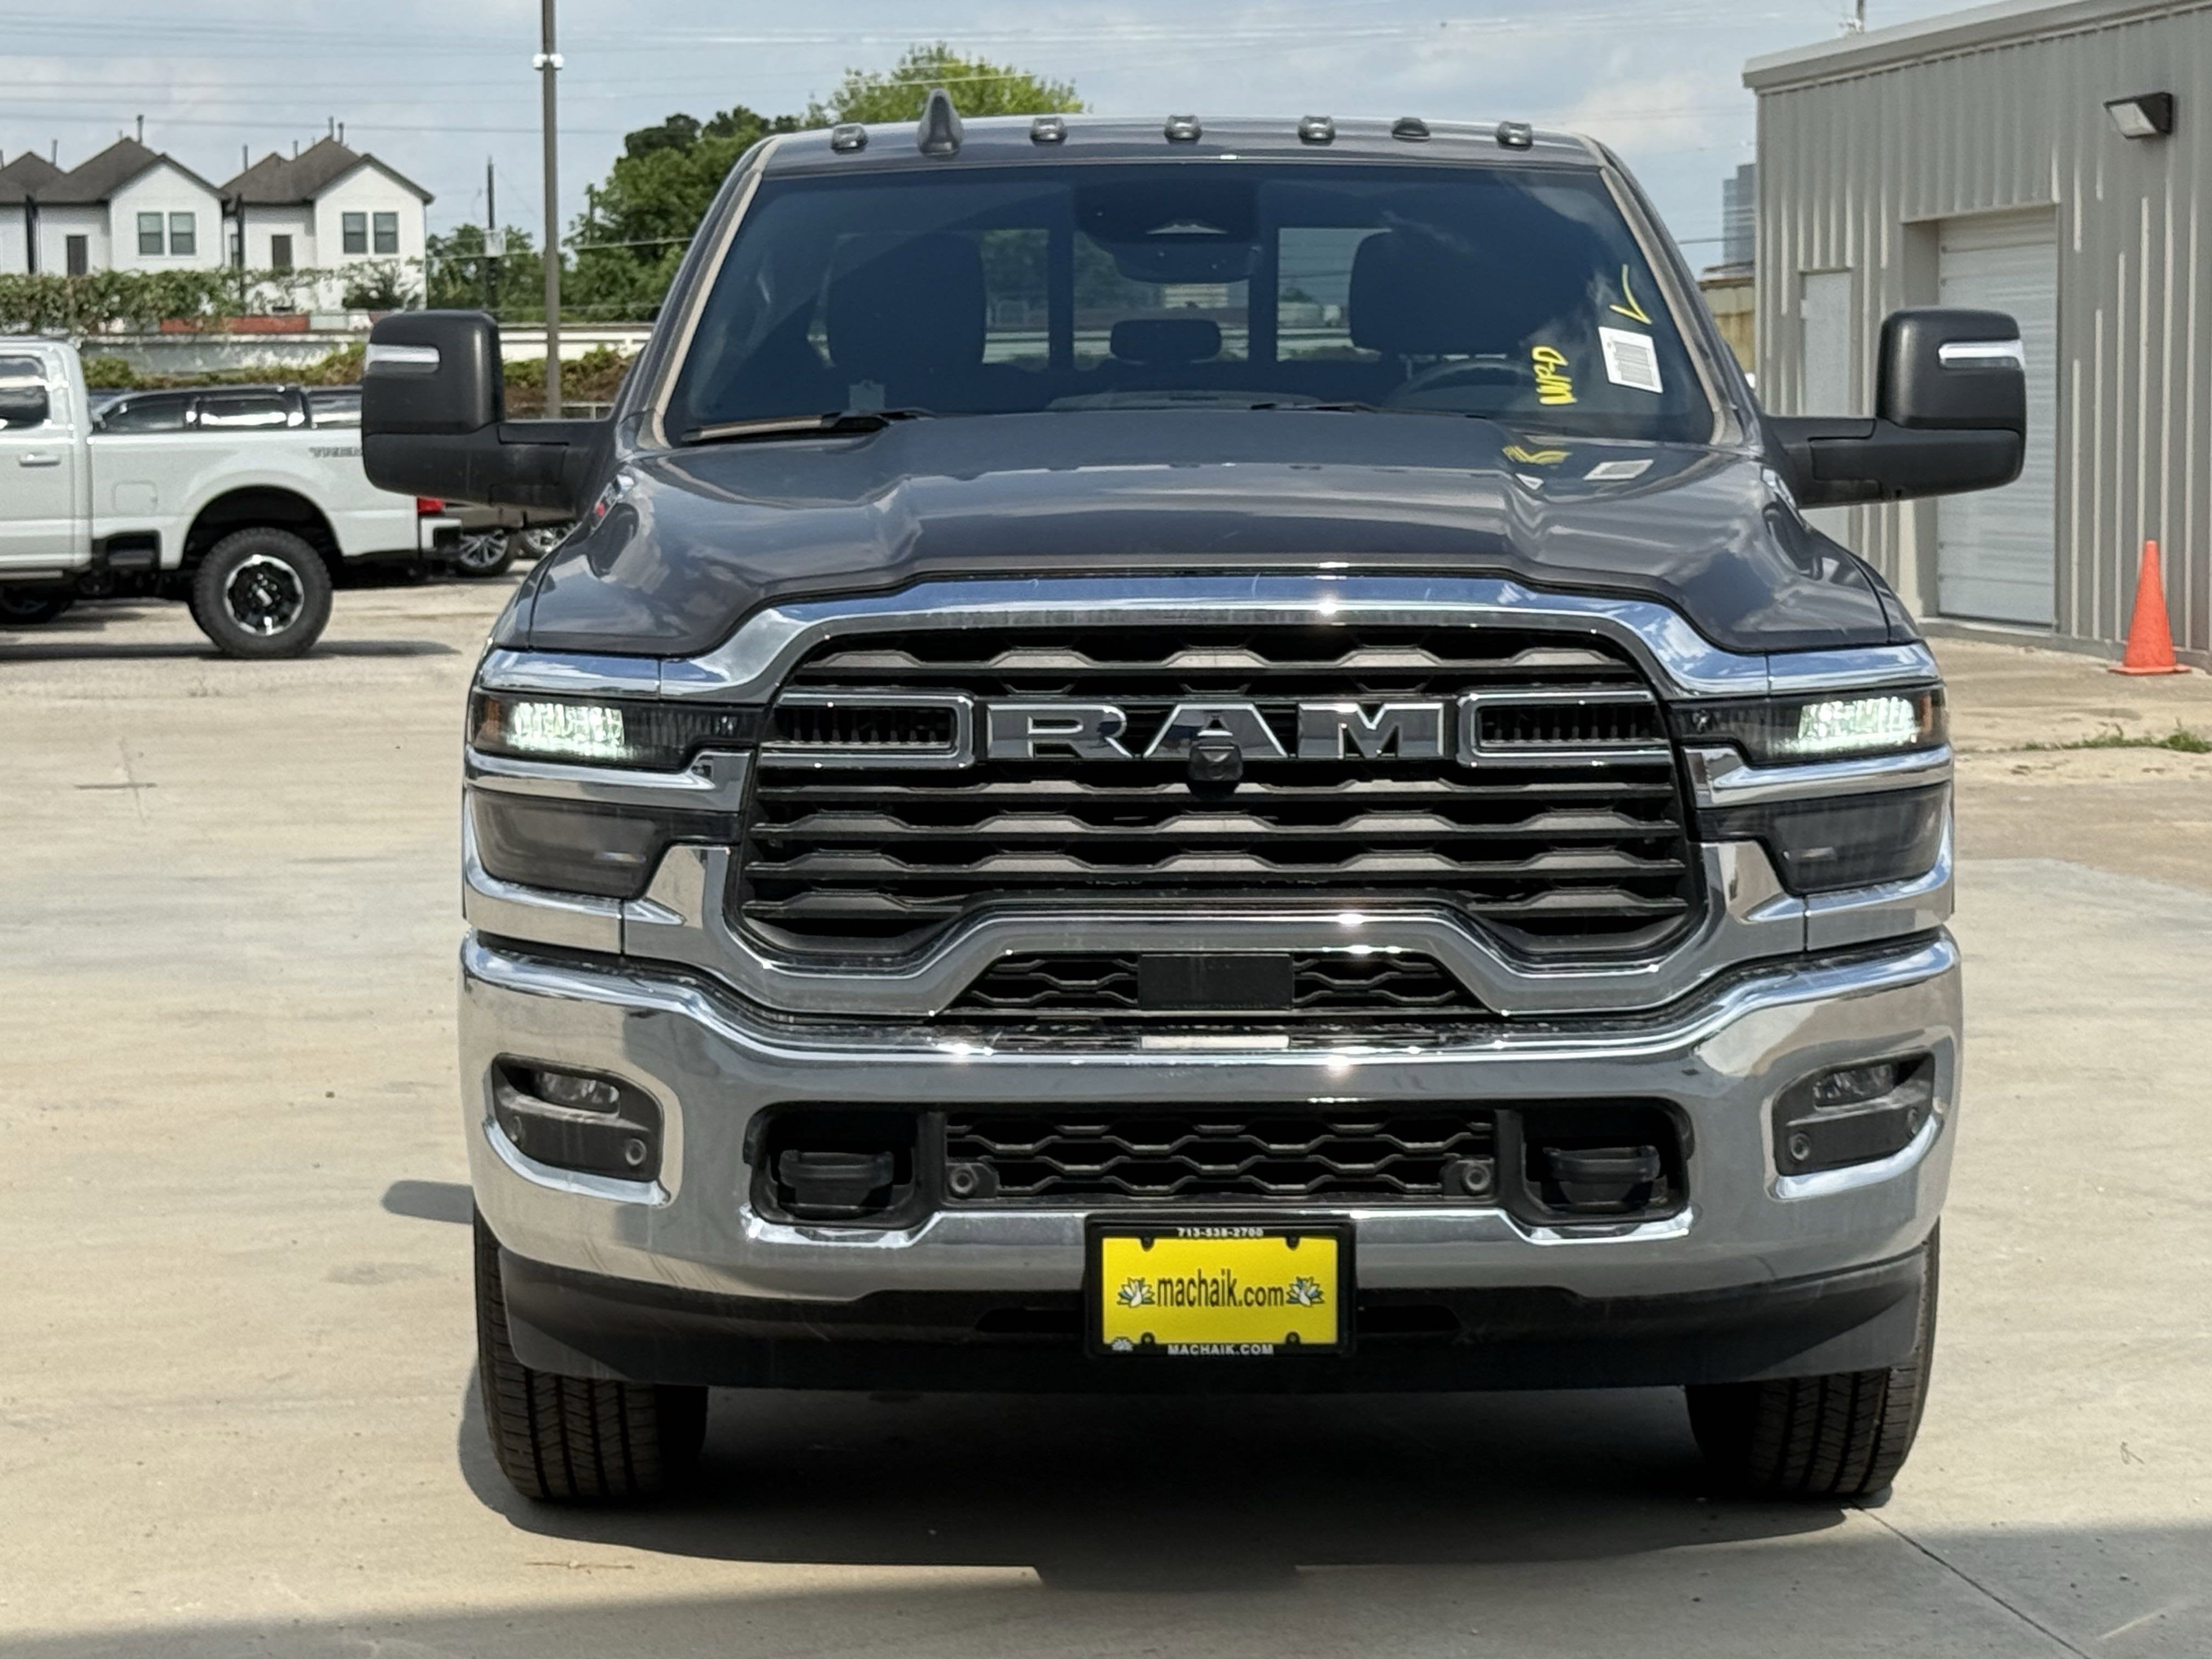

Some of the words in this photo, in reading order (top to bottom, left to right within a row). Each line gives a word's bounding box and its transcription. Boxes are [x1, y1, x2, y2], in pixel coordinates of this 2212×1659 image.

[987, 703, 1444, 759] RAM
[1157, 1268, 1284, 1307] machaik.com
[1167, 1344, 1274, 1356] MACHAIK.COM
